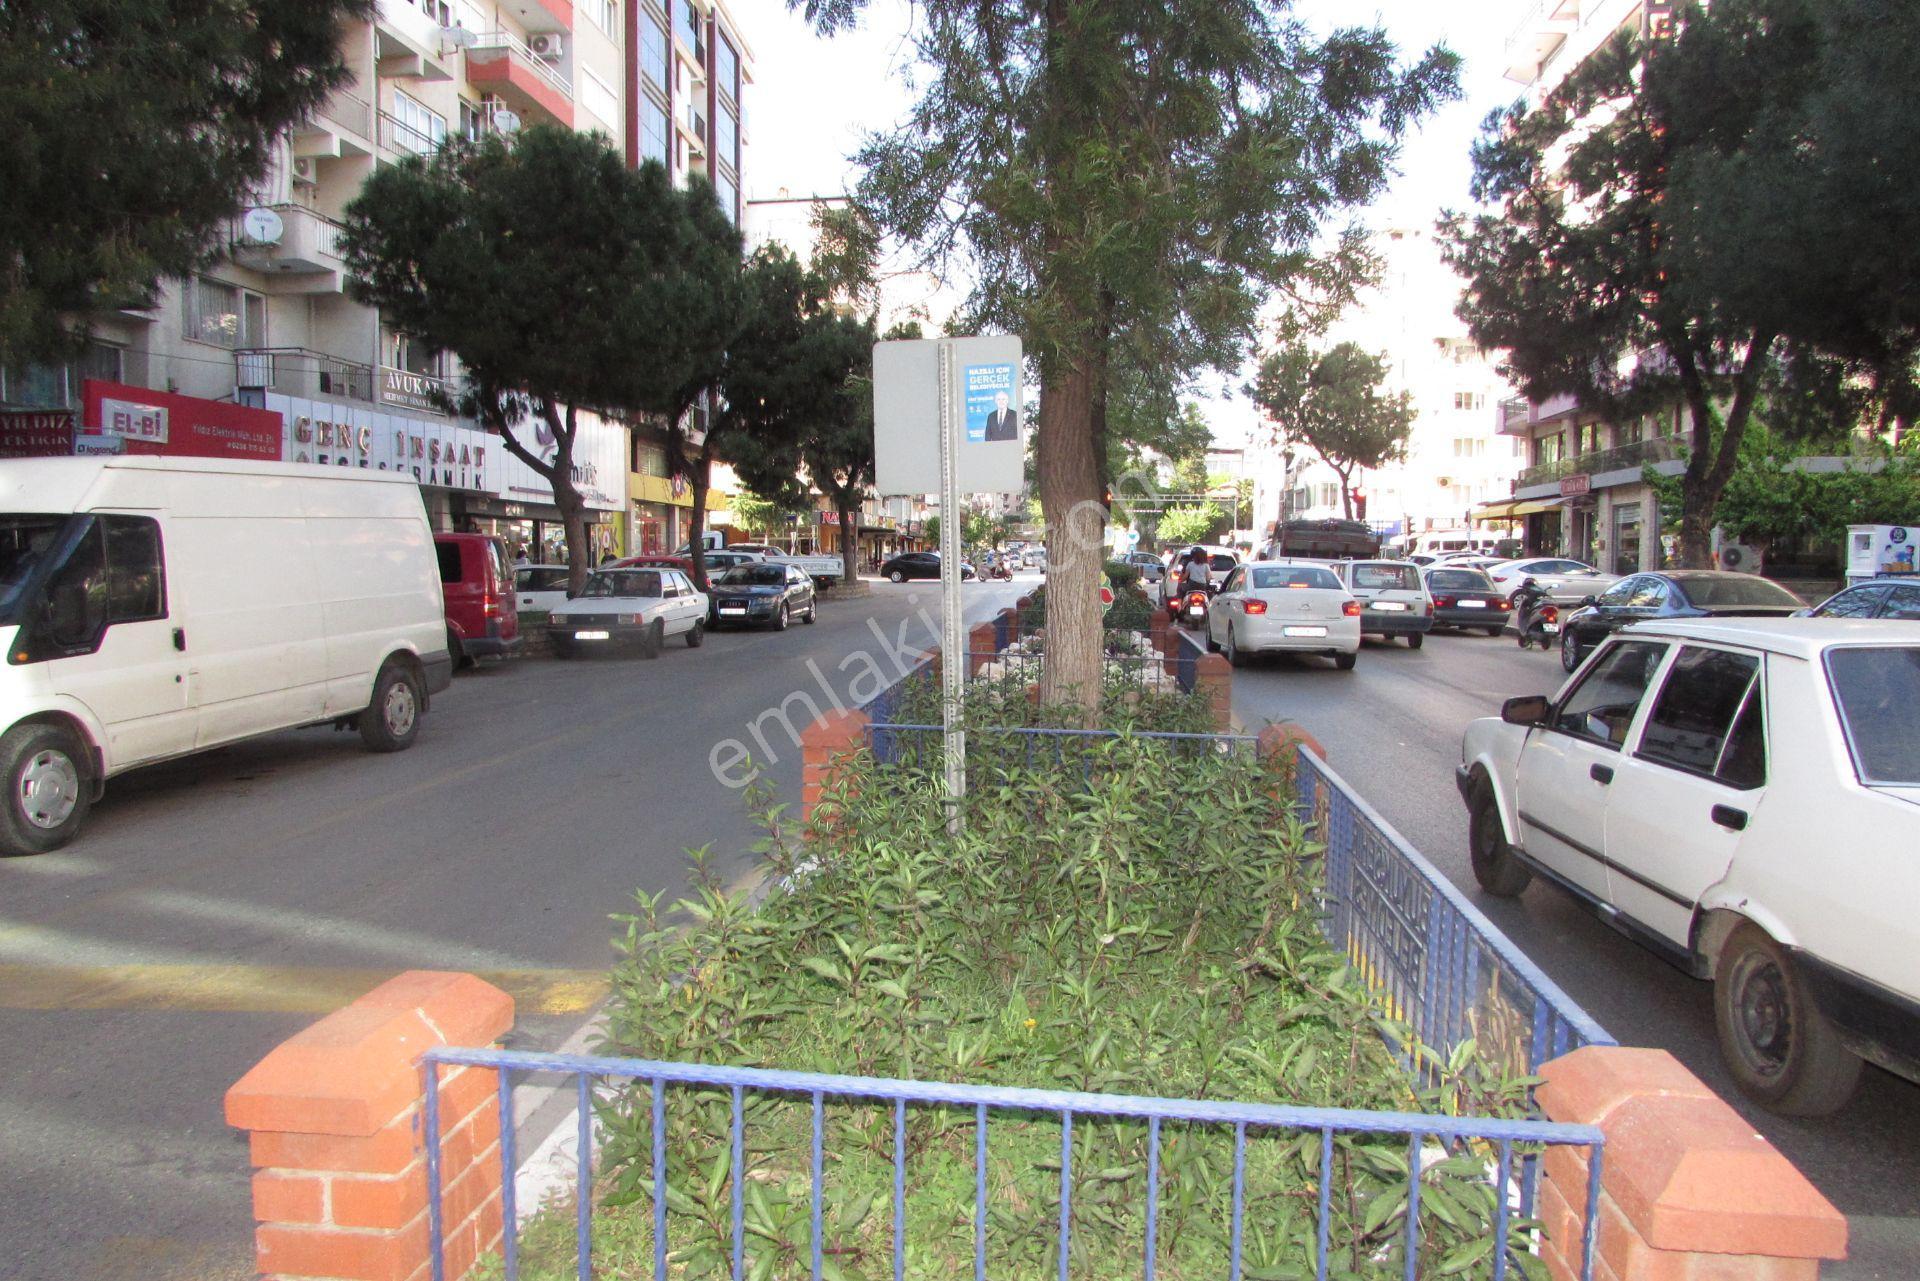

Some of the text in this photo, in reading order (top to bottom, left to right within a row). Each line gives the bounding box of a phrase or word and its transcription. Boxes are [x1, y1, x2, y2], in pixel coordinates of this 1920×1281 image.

[386, 371, 440, 396] AVUKAT
[969, 374, 1010, 384] GERÇEK
[1, 414, 70, 430] YILDIZ
[294, 415, 486, 468] GENÇ İNŞAAT
